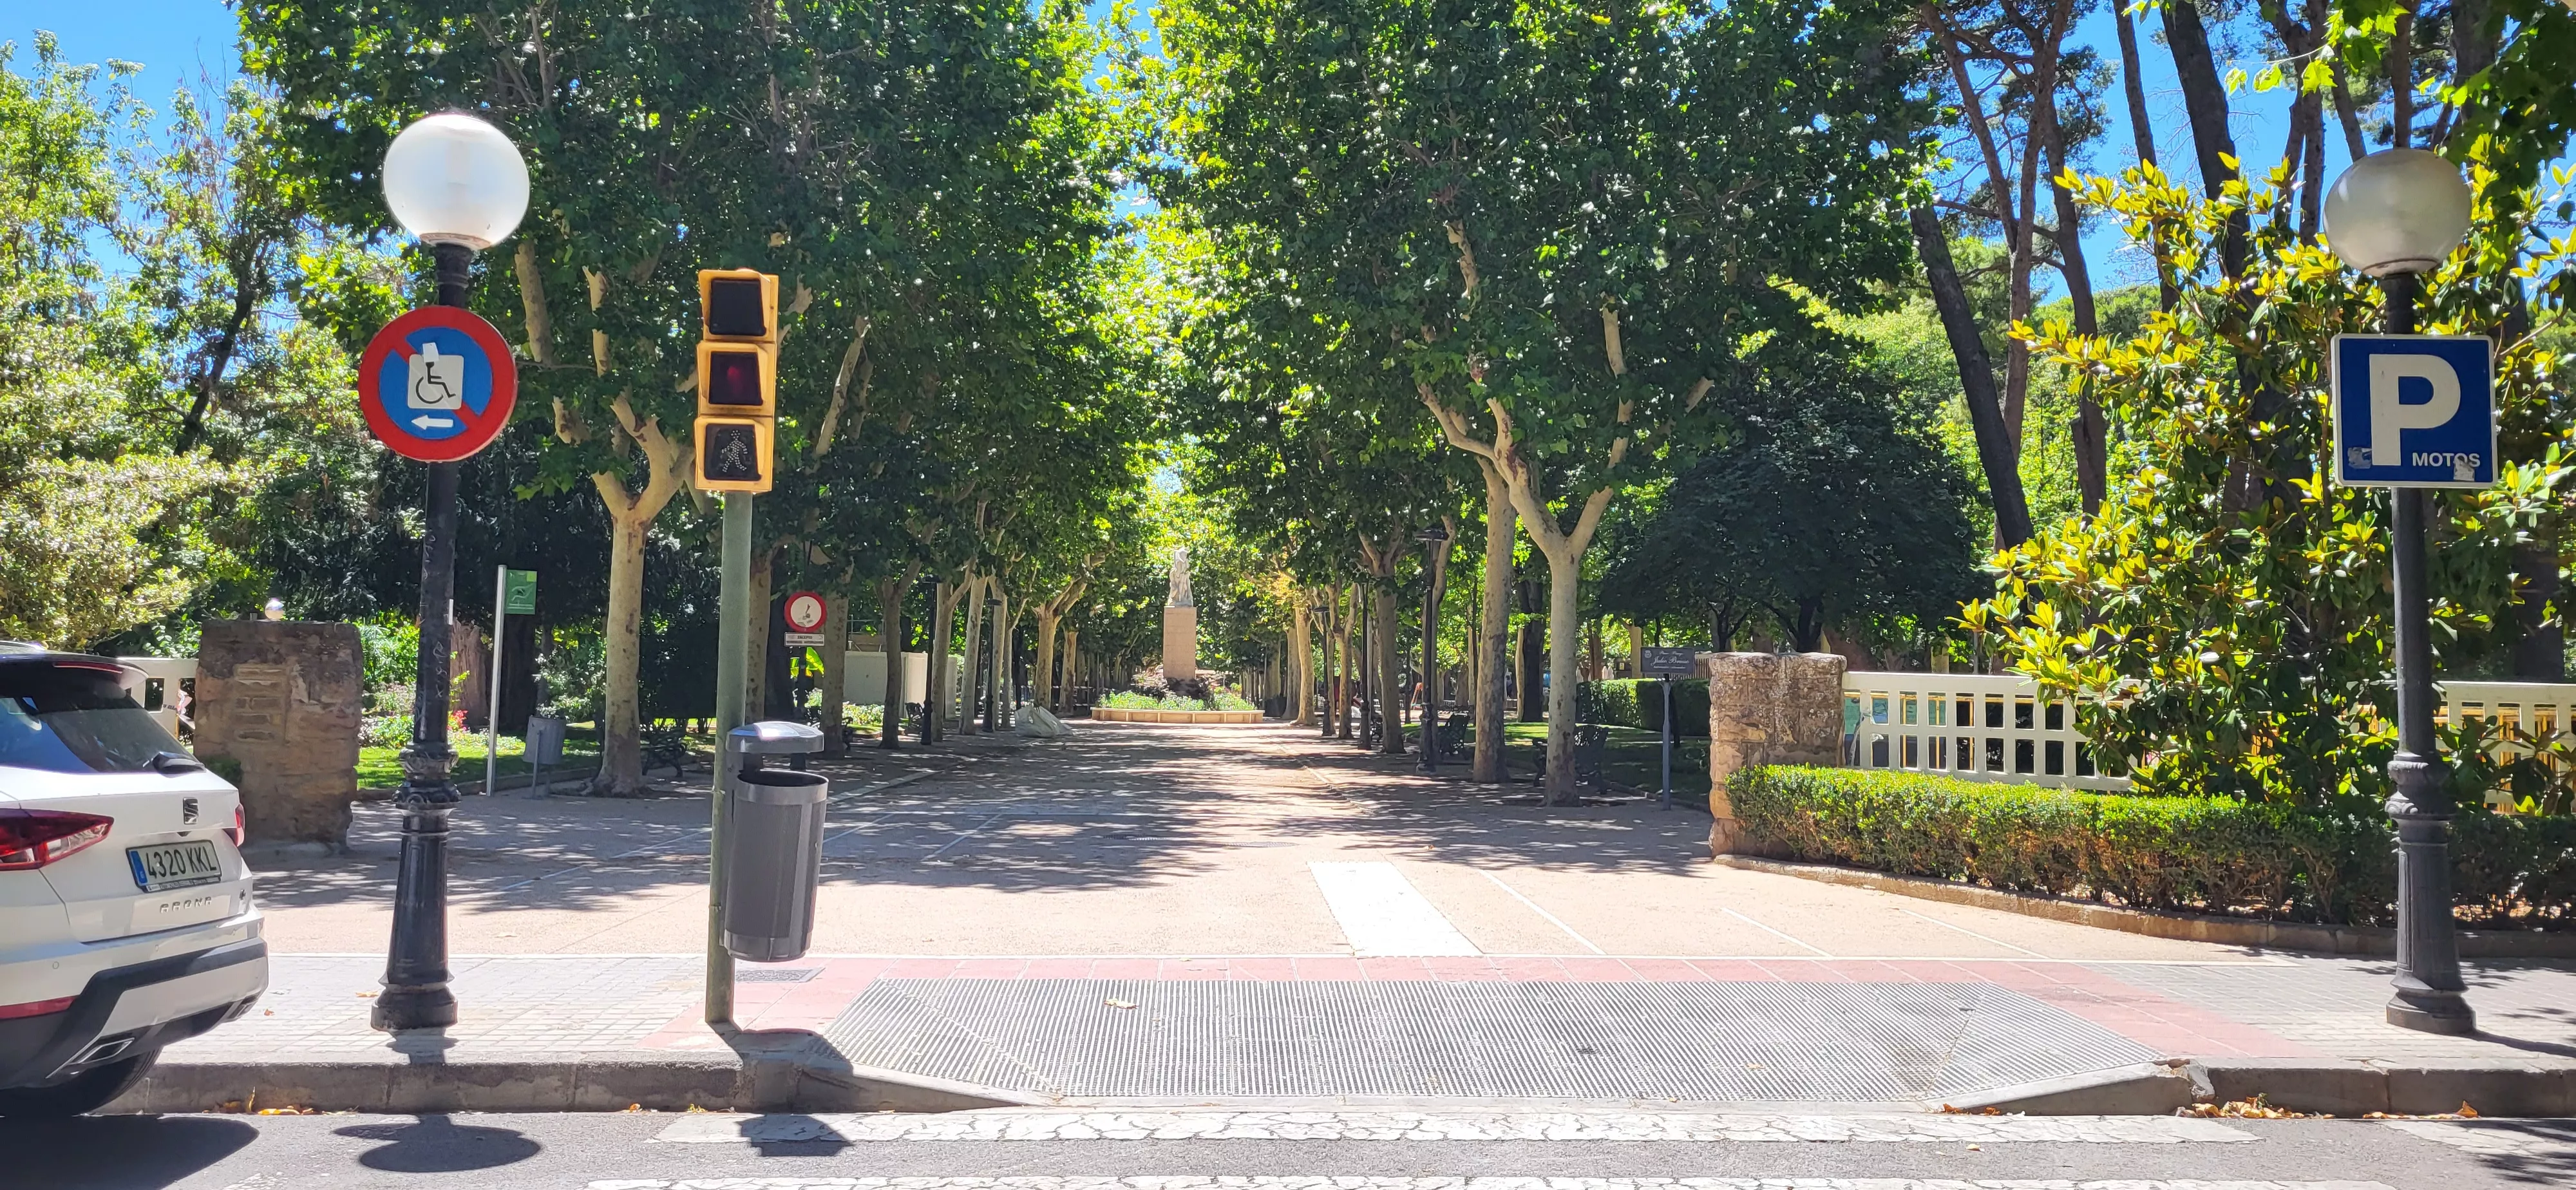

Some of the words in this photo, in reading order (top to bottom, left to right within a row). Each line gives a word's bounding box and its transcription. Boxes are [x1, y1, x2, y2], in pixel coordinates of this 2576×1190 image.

[2369, 354, 2461, 466] P
[2412, 452, 2481, 468] MOTOS
[146, 849, 187, 879] 4320
[185, 845, 217, 874] KKL
[160, 896, 212, 914] ARONA
